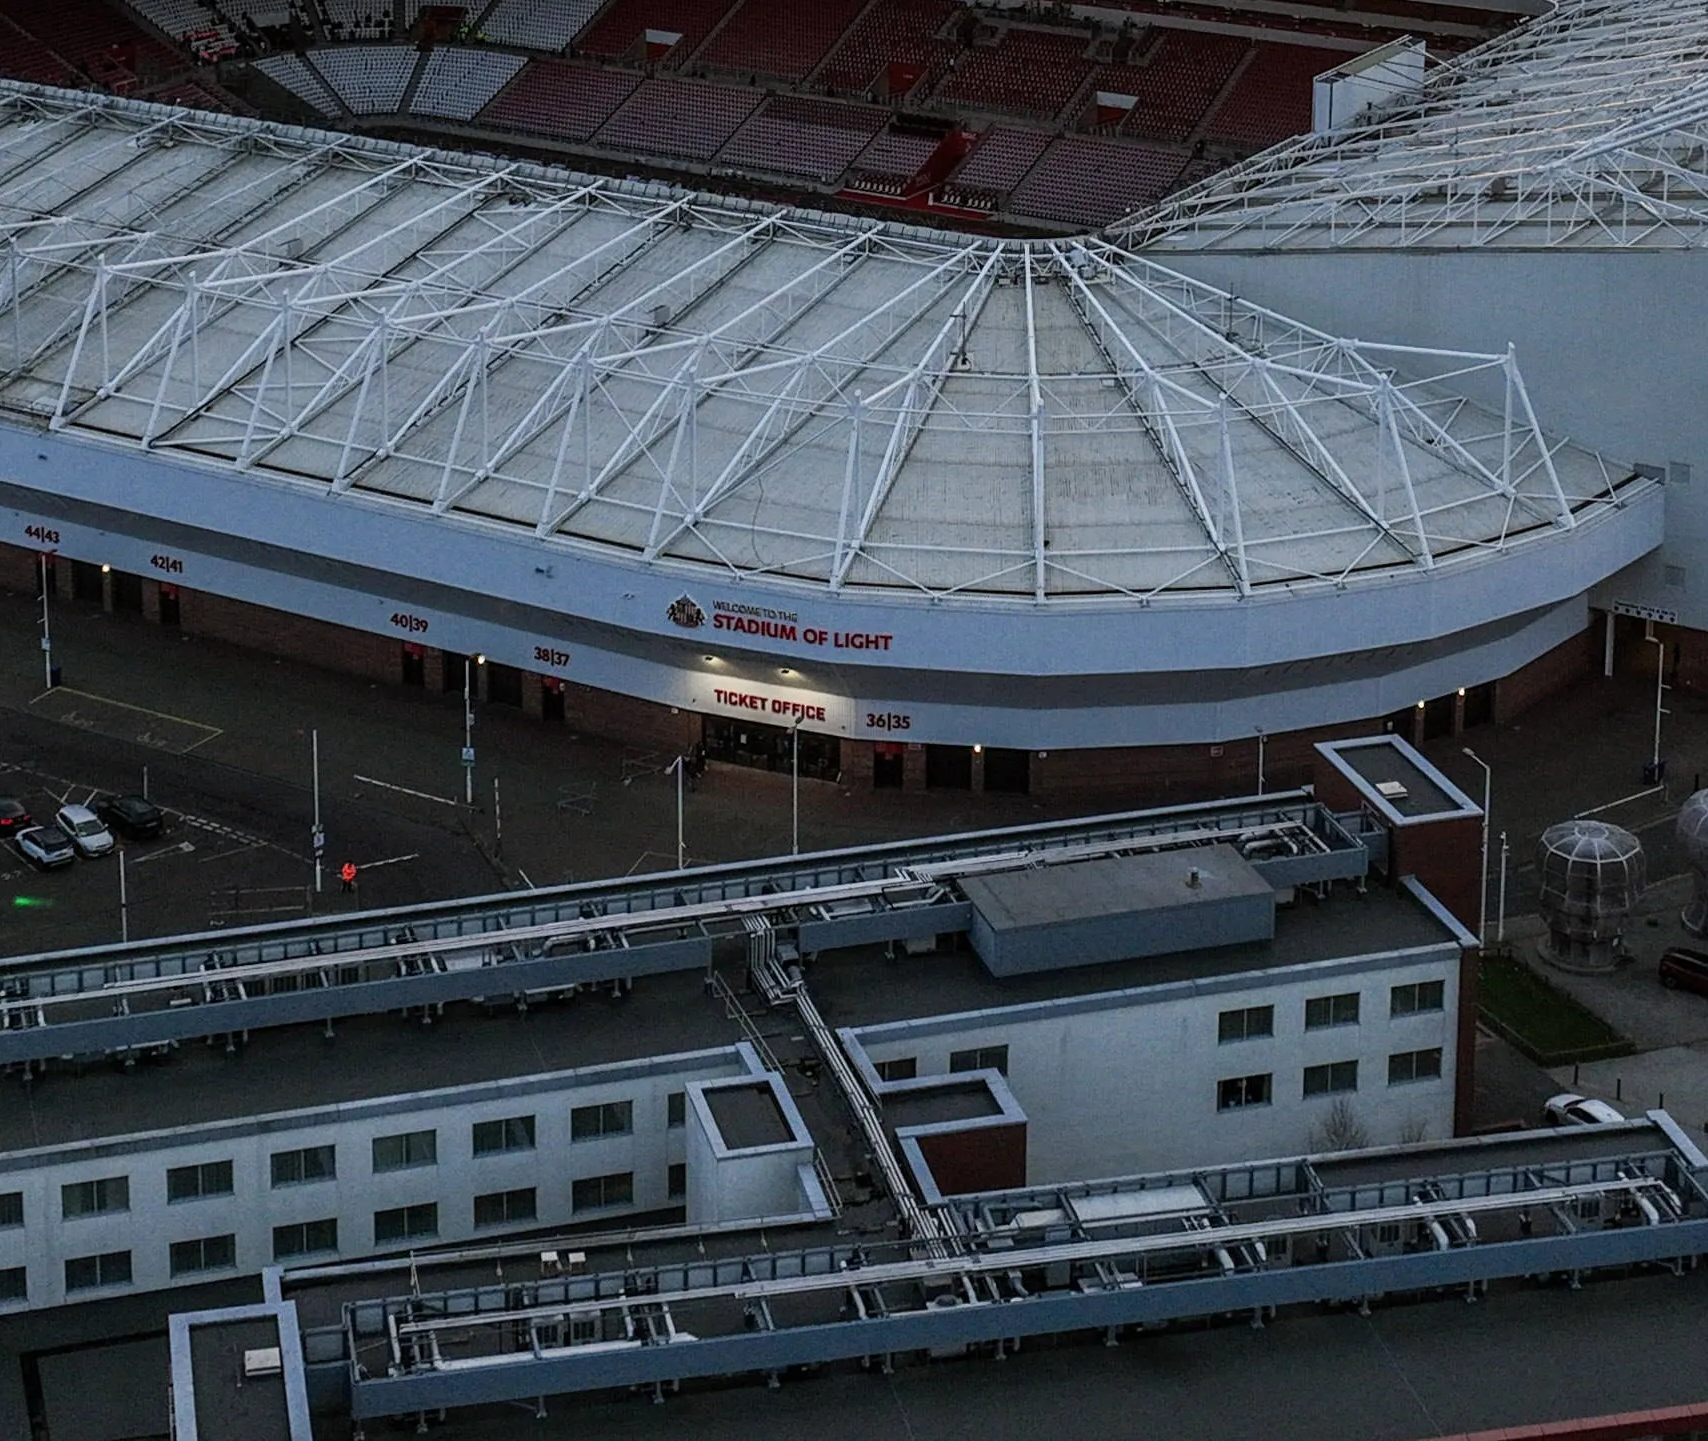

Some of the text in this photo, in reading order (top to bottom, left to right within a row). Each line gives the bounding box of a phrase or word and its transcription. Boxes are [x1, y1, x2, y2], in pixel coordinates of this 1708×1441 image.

[712, 600, 798, 623] WELCOME TO THE
[713, 613, 893, 650] STADIUM OF LIGHT
[714, 689, 826, 721] TICKET OFFICE
